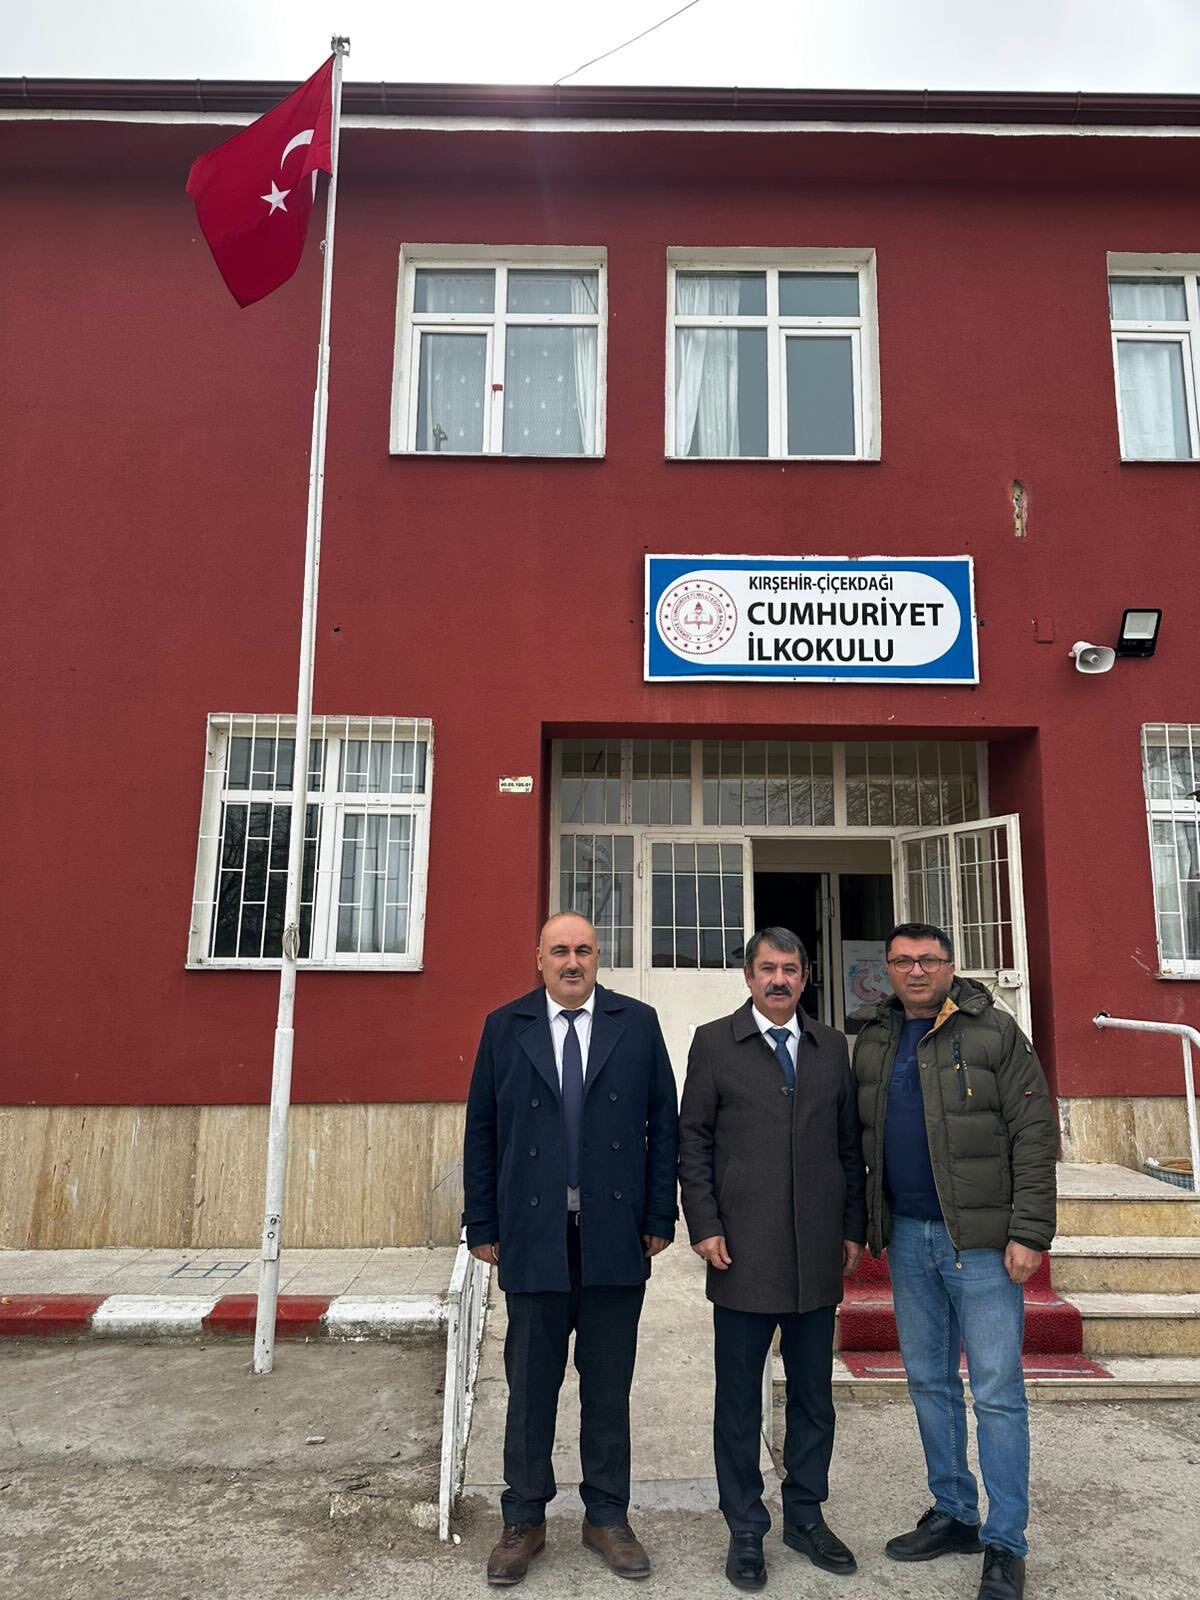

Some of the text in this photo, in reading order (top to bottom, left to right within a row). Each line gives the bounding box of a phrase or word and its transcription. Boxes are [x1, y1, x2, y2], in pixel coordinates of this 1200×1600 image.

[749, 573, 893, 594] KIRŞEHİR-ÇİÇEKDAĞI
[747, 596, 944, 626] CUMHURİYET
[748, 631, 894, 662] İLKOKULU
